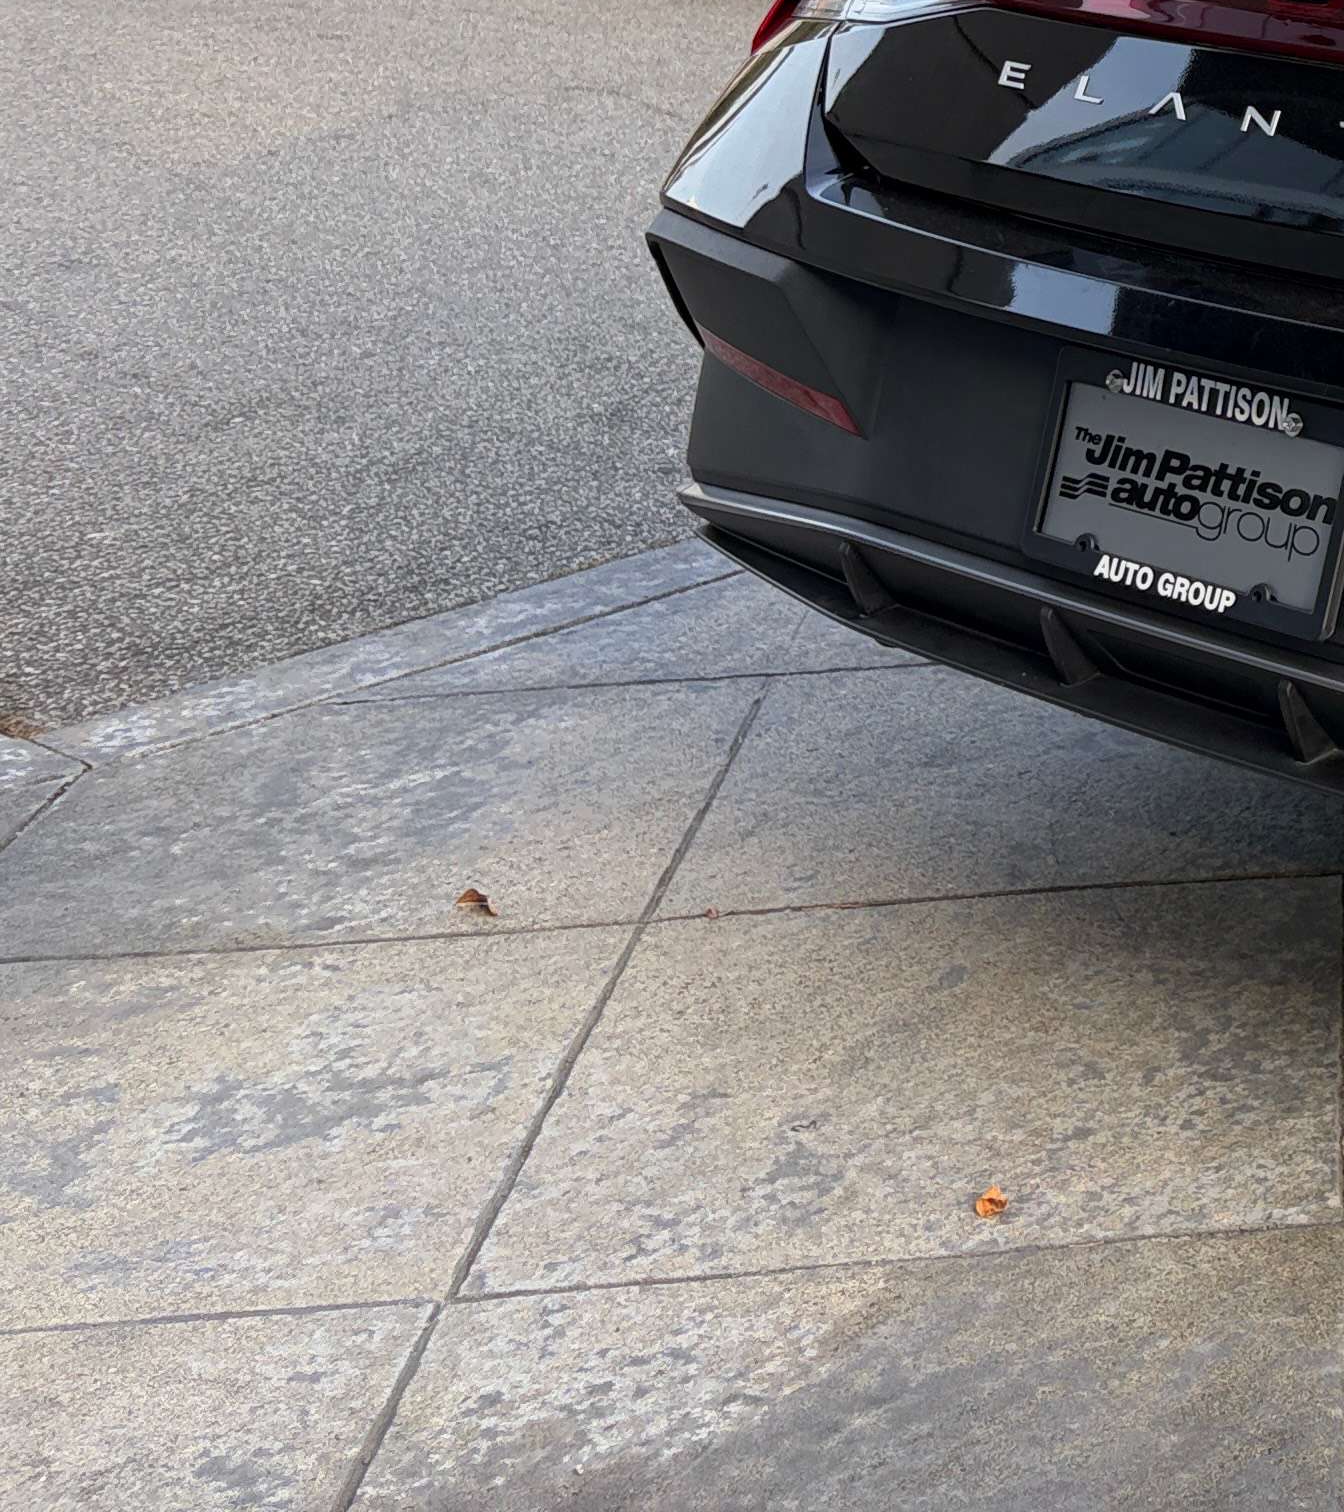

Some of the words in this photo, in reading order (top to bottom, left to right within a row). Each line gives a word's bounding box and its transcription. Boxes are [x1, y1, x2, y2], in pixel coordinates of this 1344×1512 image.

[1122, 362, 1164, 400] JIM
[1170, 372, 1291, 430] PATTISON
[1075, 426, 1103, 446] The
[1094, 555, 1154, 591] AUTO
[1157, 572, 1236, 613] GROUP
